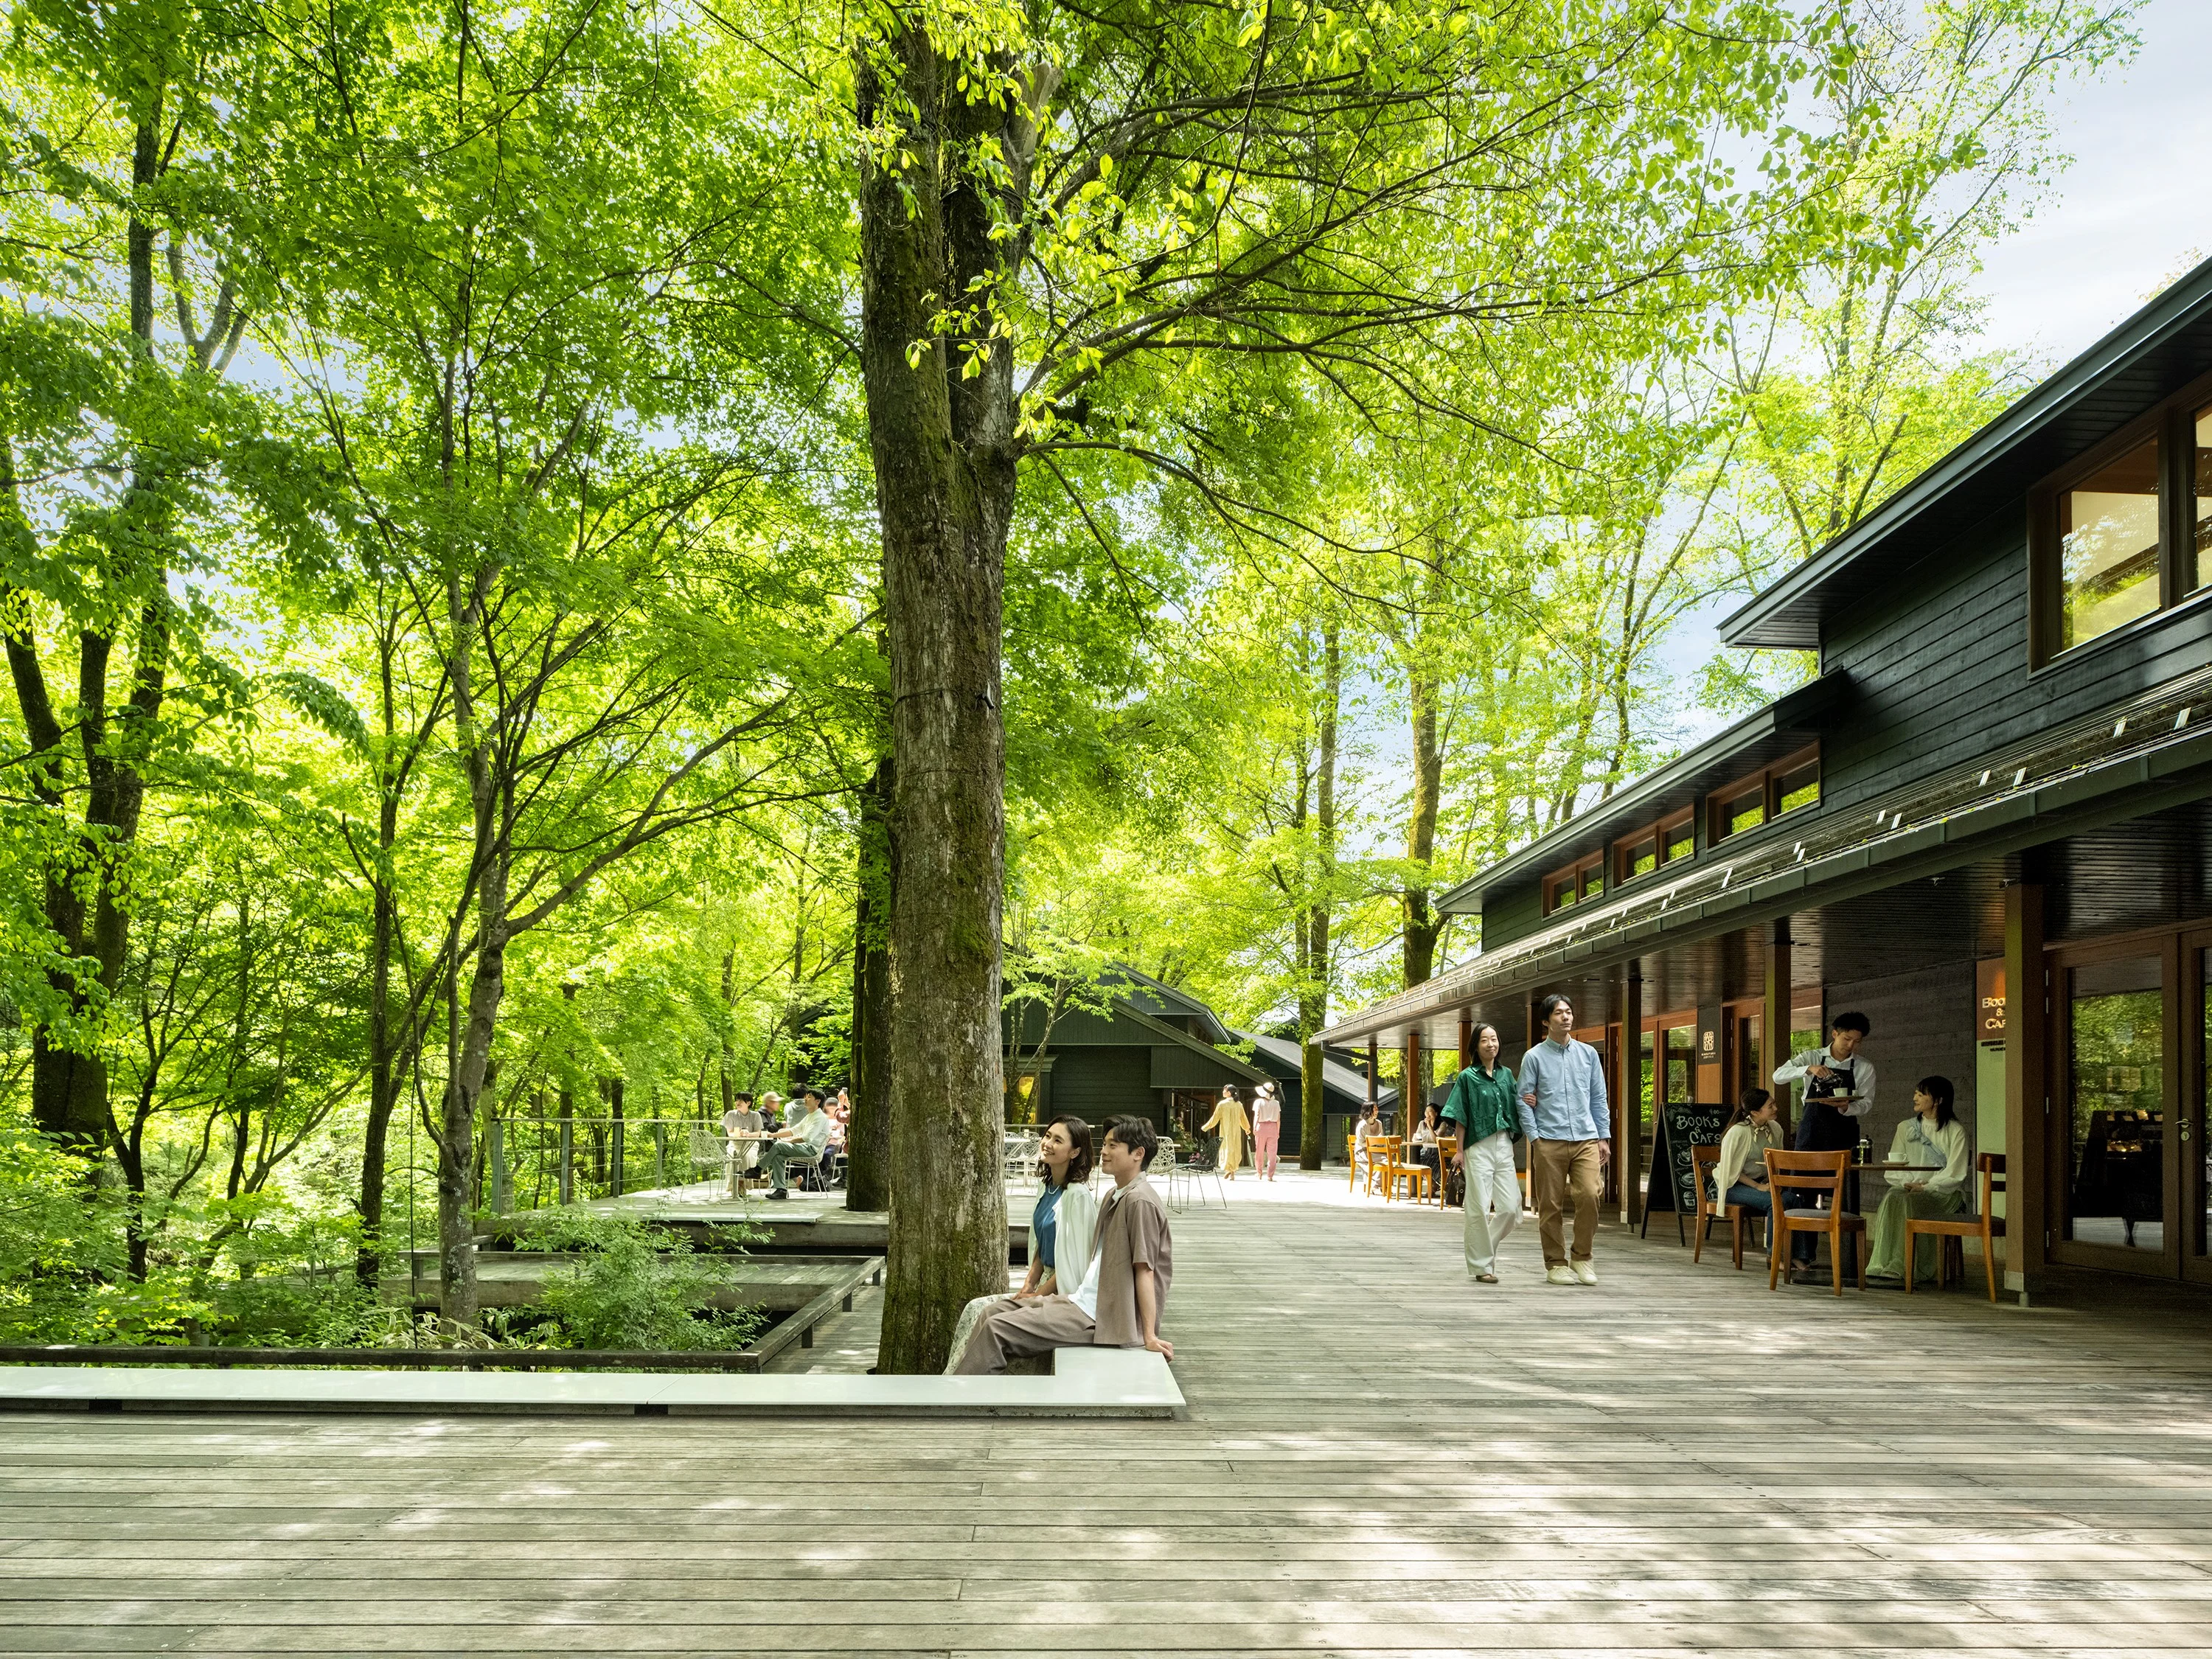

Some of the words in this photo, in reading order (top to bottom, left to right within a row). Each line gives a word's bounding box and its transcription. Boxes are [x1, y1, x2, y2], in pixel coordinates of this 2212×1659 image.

[1982, 997, 2006, 1009] BOO
[1996, 1007, 2003, 1016] &
[1985, 1018, 2006, 1029] CAF
[1676, 1115, 1720, 1130] BOOKS
[1689, 1131, 1722, 1144] CAFE
